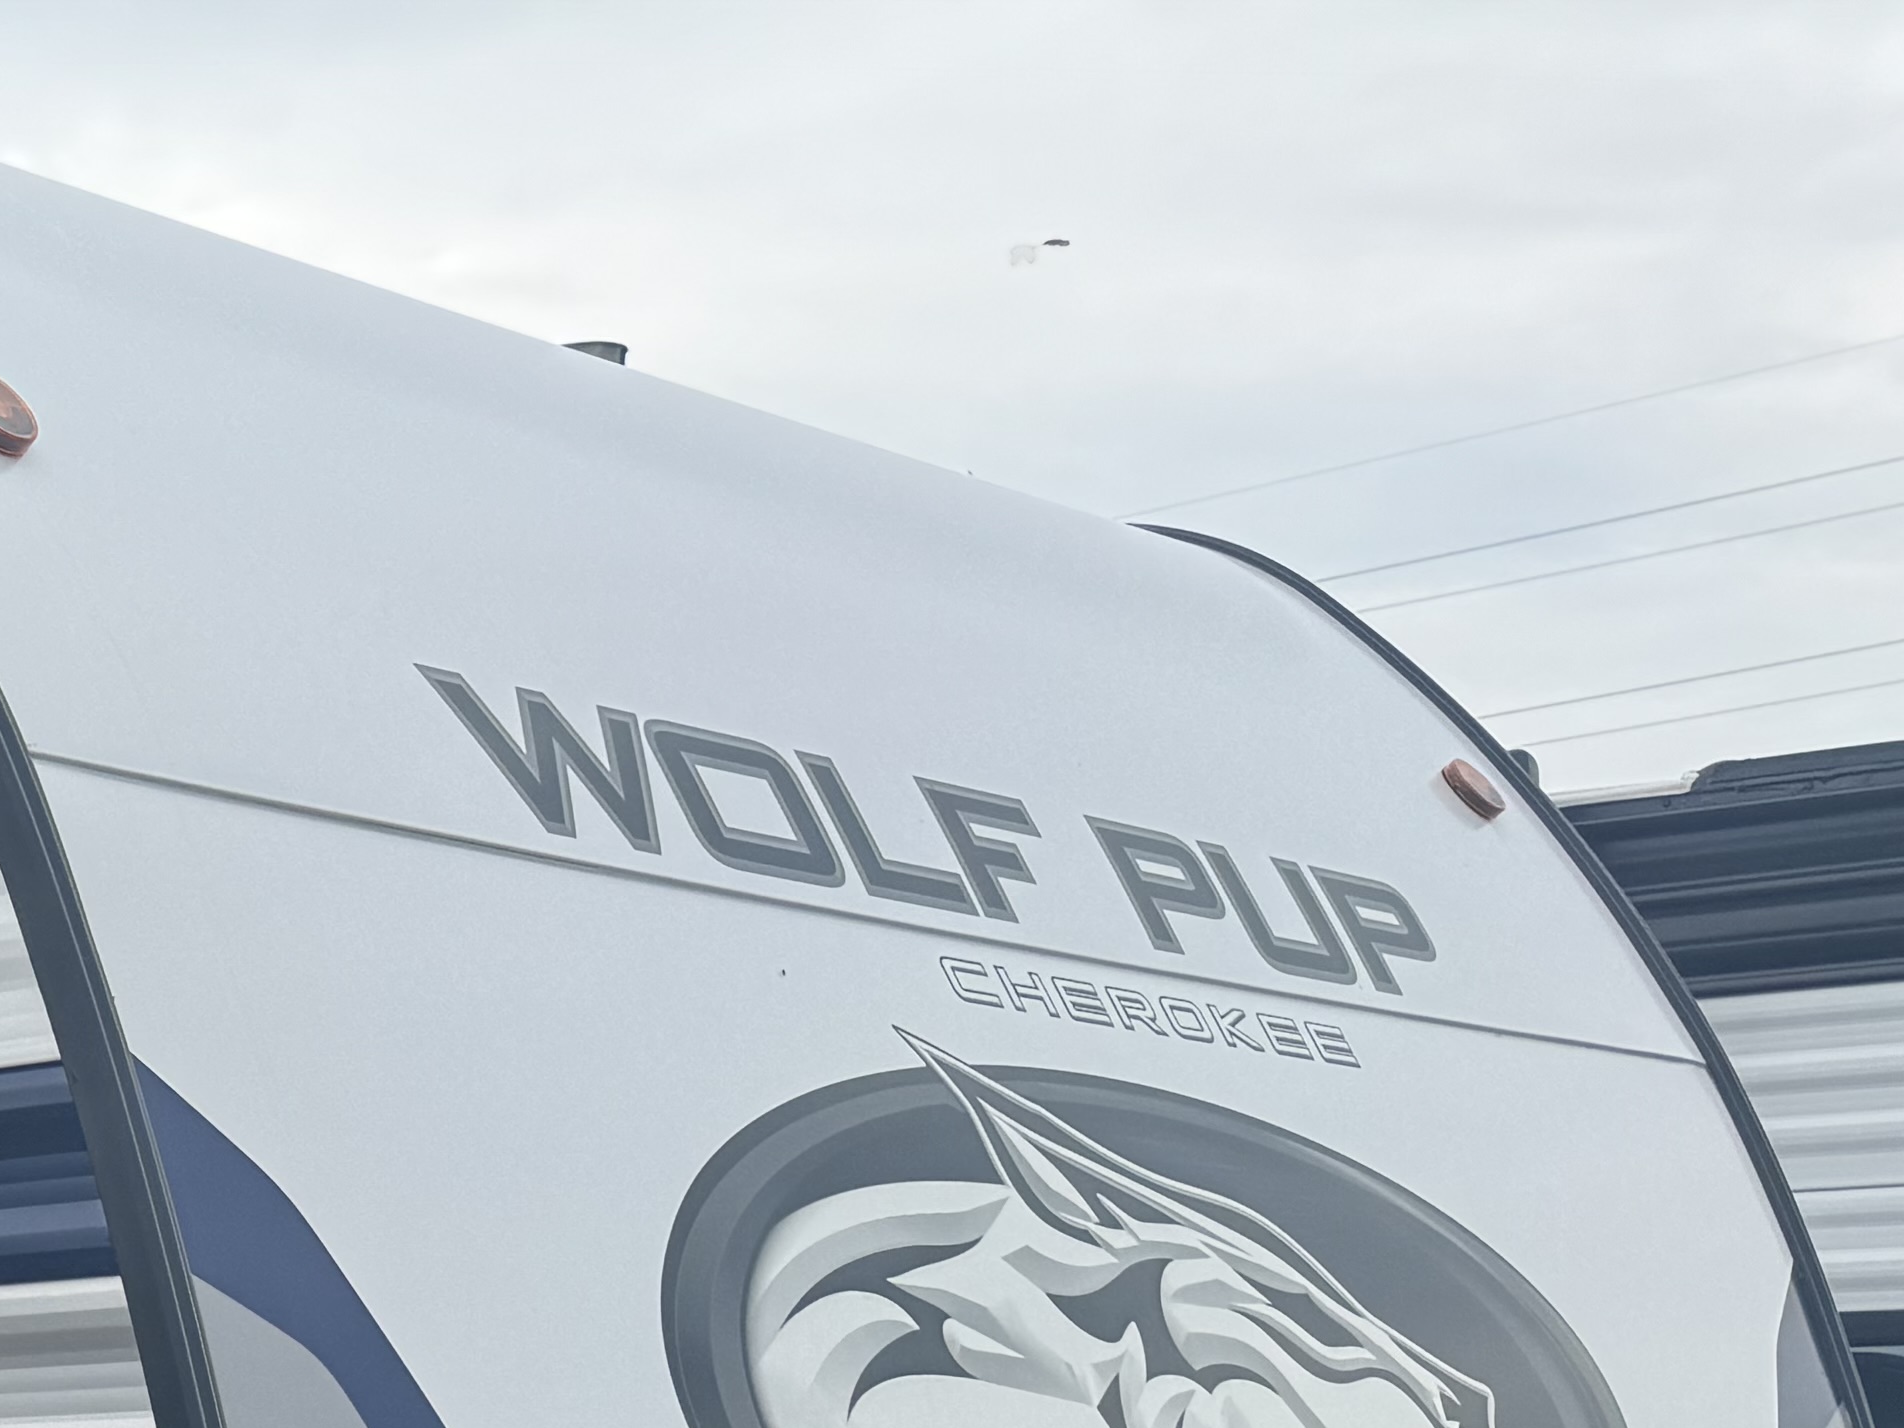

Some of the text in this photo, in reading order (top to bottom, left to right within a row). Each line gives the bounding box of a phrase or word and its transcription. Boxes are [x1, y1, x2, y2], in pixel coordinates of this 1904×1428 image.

[412, 663, 1437, 995] WOLF PUP
[939, 955, 1362, 1069] CHEROKEE
